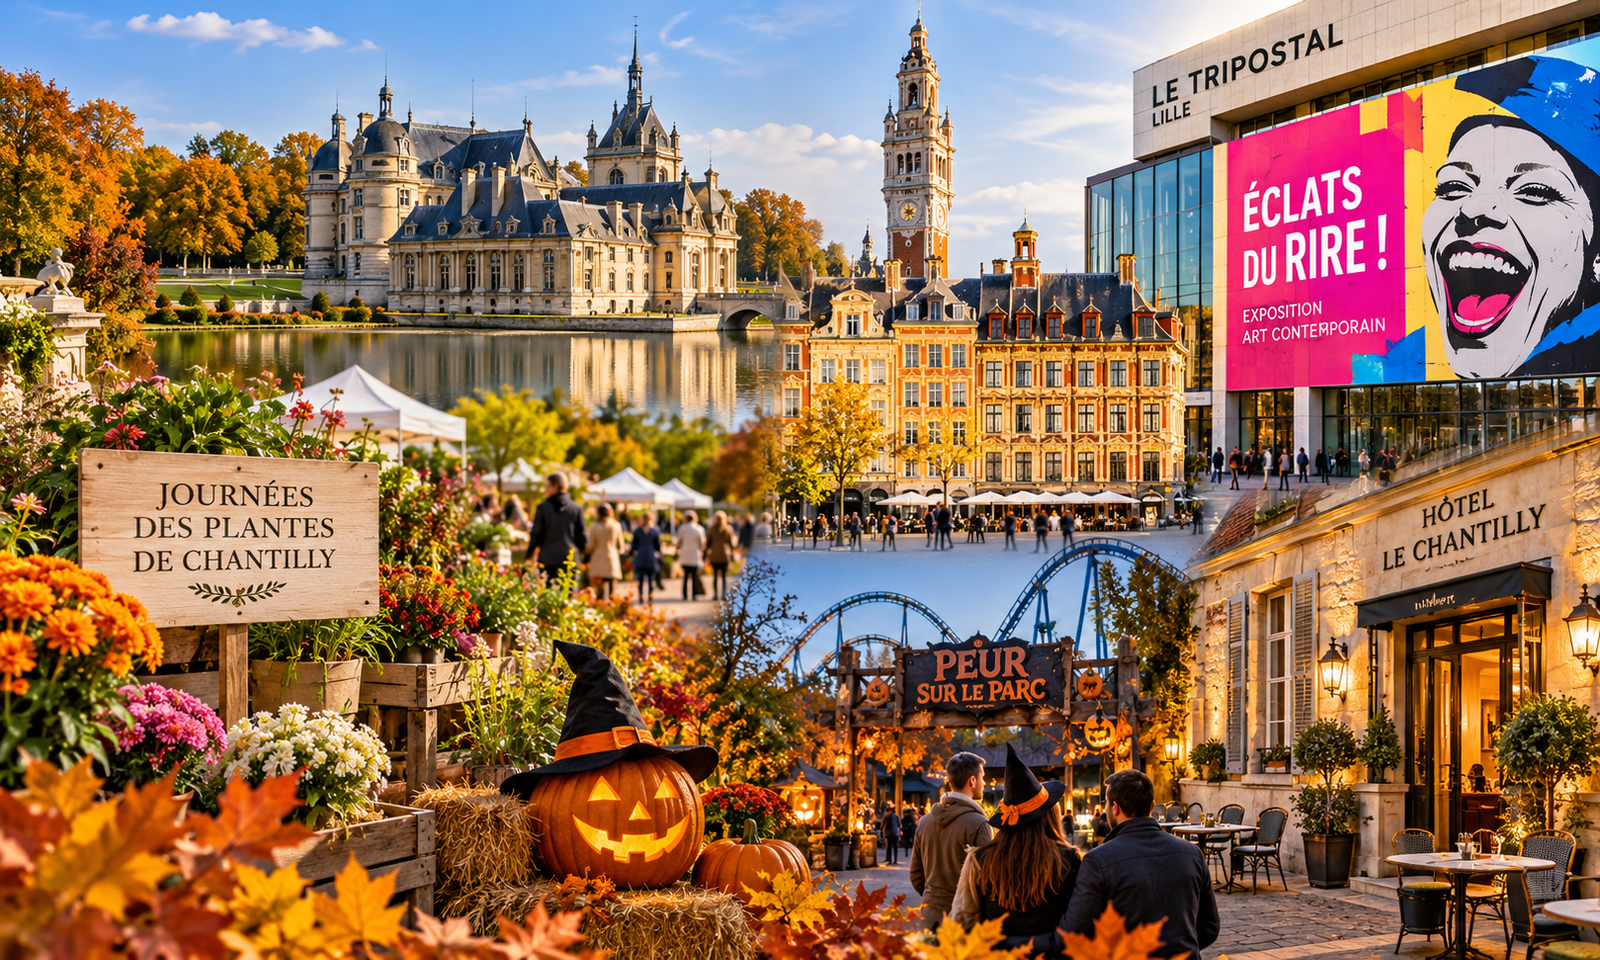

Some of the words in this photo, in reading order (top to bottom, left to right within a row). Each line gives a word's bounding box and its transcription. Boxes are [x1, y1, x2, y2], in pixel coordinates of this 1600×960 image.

[1152, 77, 1179, 108] LE
[1188, 22, 1344, 95] TRIPOSTAL
[1152, 103, 1191, 128] LILLE
[1243, 165, 1363, 233] ÉCLATS
[1243, 245, 1277, 289] DU
[1285, 219, 1366, 283] RIRE
[1377, 214, 1388, 270] !
[1243, 300, 1322, 323] EXPOSITION
[1242, 328, 1268, 344] ART
[1271, 317, 1386, 341] CONTEMPORAIN
[155, 479, 314, 511] JOURNÉES
[1421, 488, 1495, 529] HÔTEL
[133, 516, 192, 539] DES
[204, 516, 335, 539] PLANTES
[1382, 546, 1406, 571] LE
[1412, 504, 1547, 561] CHANTILLY
[133, 549, 174, 573] DE
[182, 548, 336, 571] CHANTILLY
[933, 646, 1031, 682] PEUR
[917, 683, 958, 704] SUR
[961, 684, 984, 702] LE
[988, 678, 1046, 704] PARC
